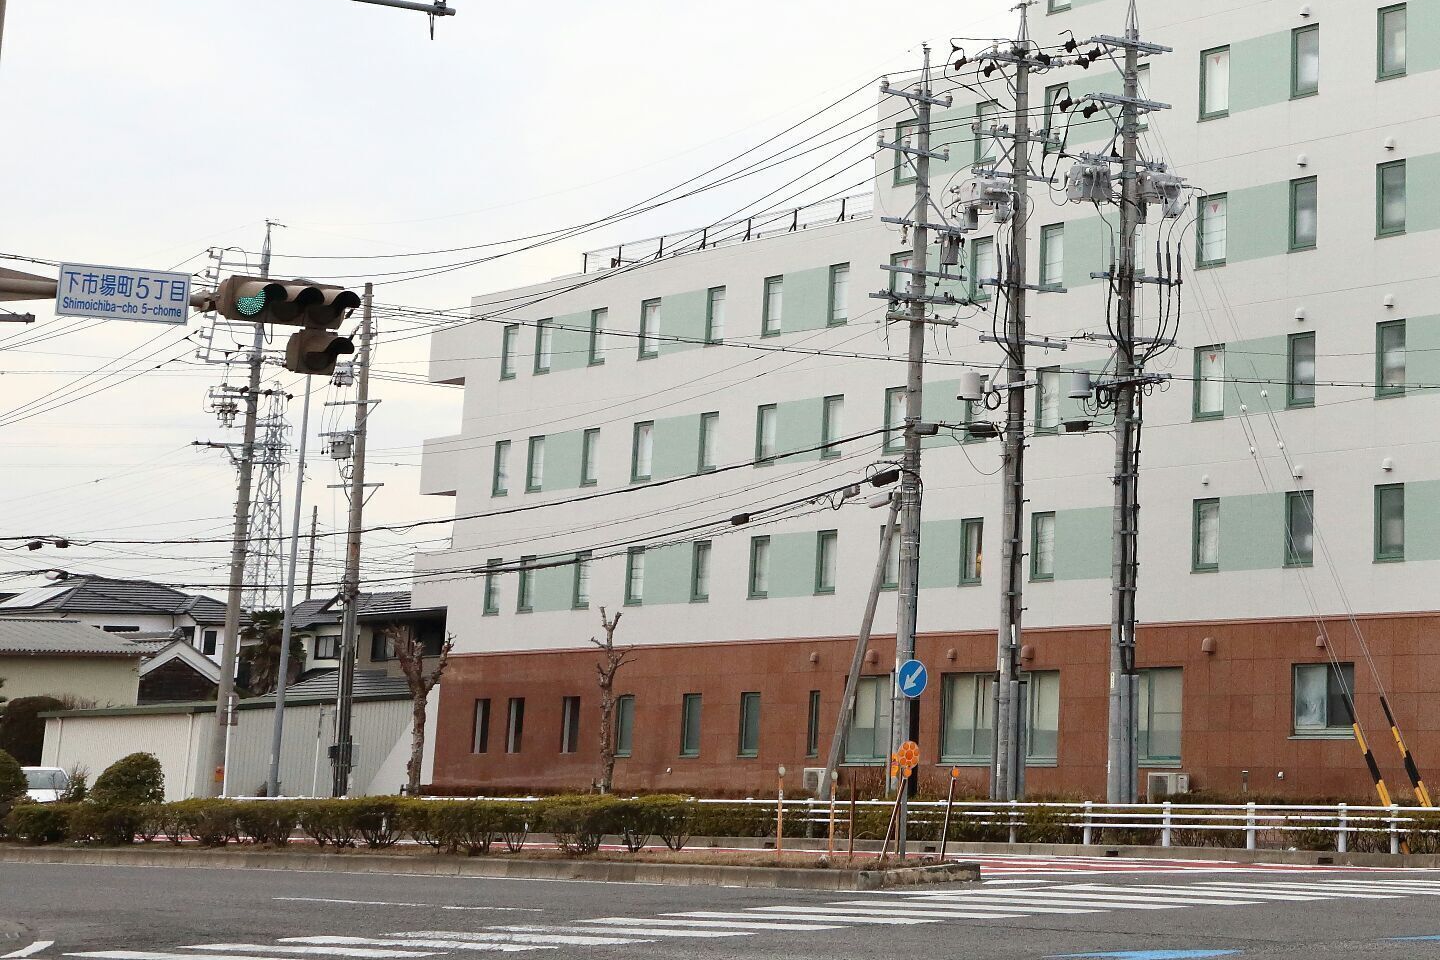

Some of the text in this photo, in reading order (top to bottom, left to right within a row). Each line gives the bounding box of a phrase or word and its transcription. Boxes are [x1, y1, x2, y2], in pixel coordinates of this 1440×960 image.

[64, 271, 186, 302] 下市場町5丁目
[62, 296, 181, 317] Shimoichiba-cho 5-chome
